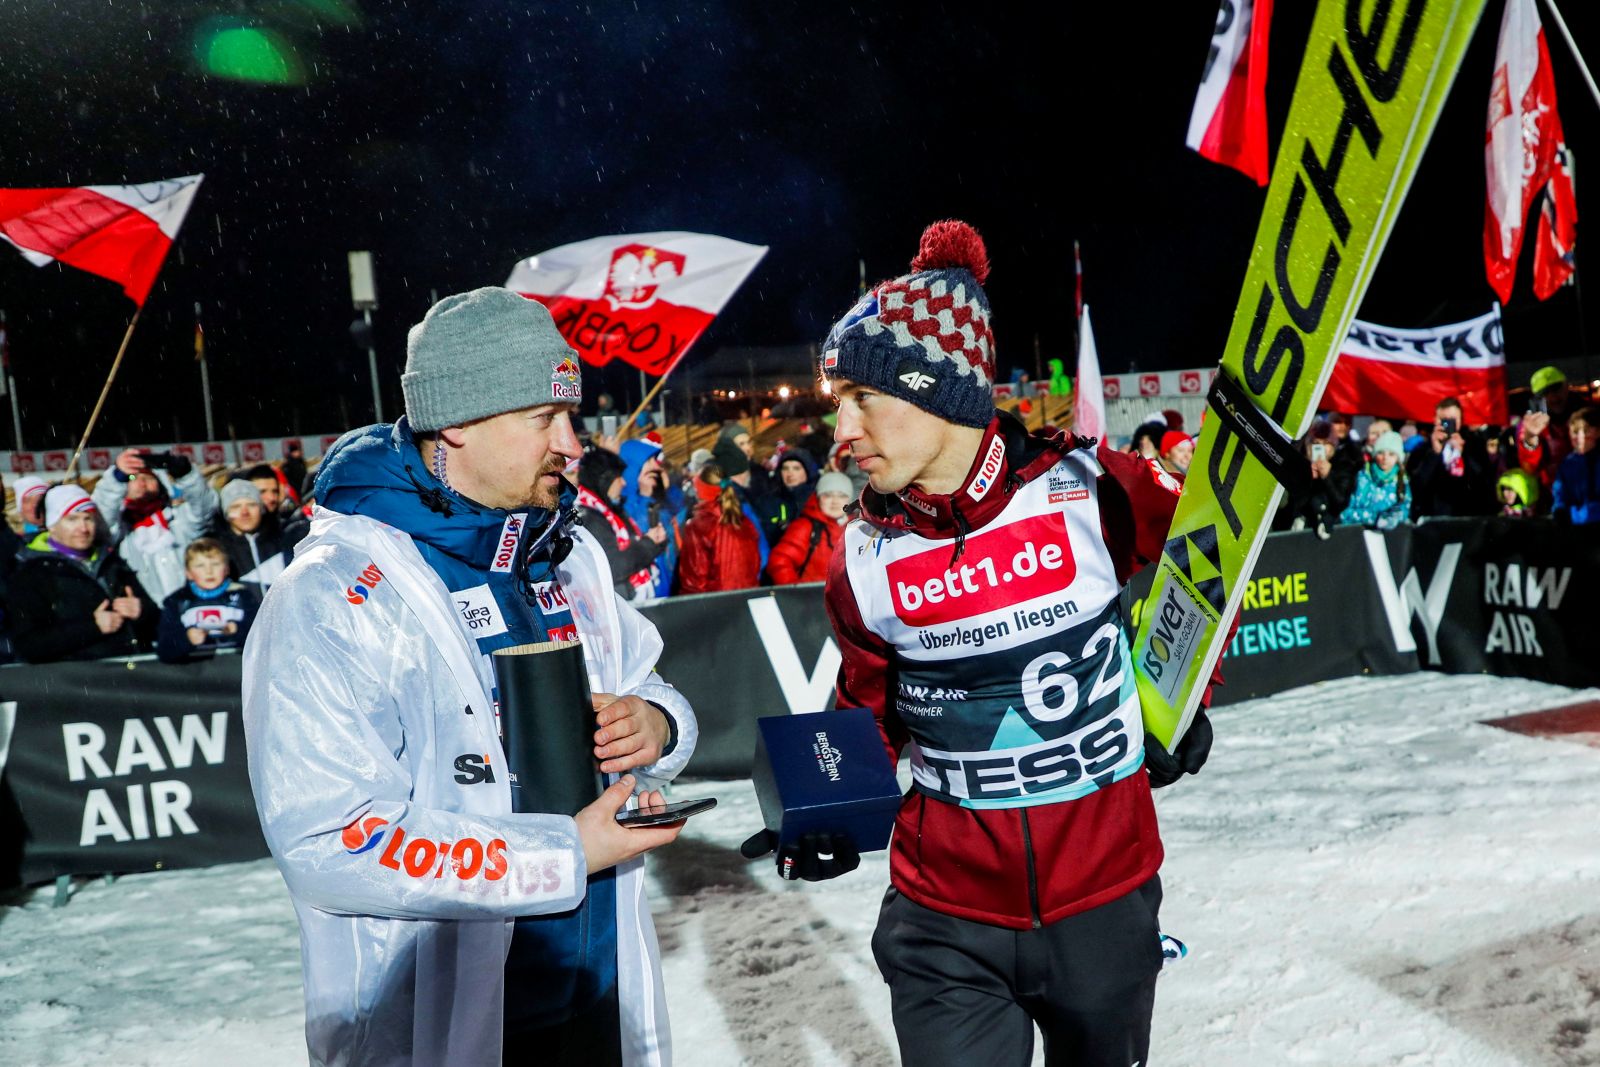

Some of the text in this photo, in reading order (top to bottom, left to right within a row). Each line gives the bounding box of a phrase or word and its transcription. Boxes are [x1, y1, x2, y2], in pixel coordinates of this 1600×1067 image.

[899, 371, 936, 391] 4F
[982, 441, 1003, 479] LOTOS
[1049, 479, 1081, 488] JUMPING
[496, 532, 519, 568] LOTOS
[897, 541, 1063, 611] bett1.de
[1163, 563, 1218, 624] FISCHER
[1243, 572, 1309, 611] REME
[1485, 562, 1572, 610] RAW
[468, 616, 491, 630] OTY
[918, 600, 1079, 650] Überlegen liegen
[1173, 610, 1197, 661] SAINT-GOBAIN
[1223, 616, 1311, 658] TENSE
[1485, 611, 1544, 657] AIR
[1021, 622, 1125, 722] 62
[62, 711, 228, 782] RAW
[815, 732, 841, 781] BERGSTERN
[921, 718, 1128, 800] TESS
[79, 780, 200, 847] AIR
[379, 826, 508, 881] LOTOS
